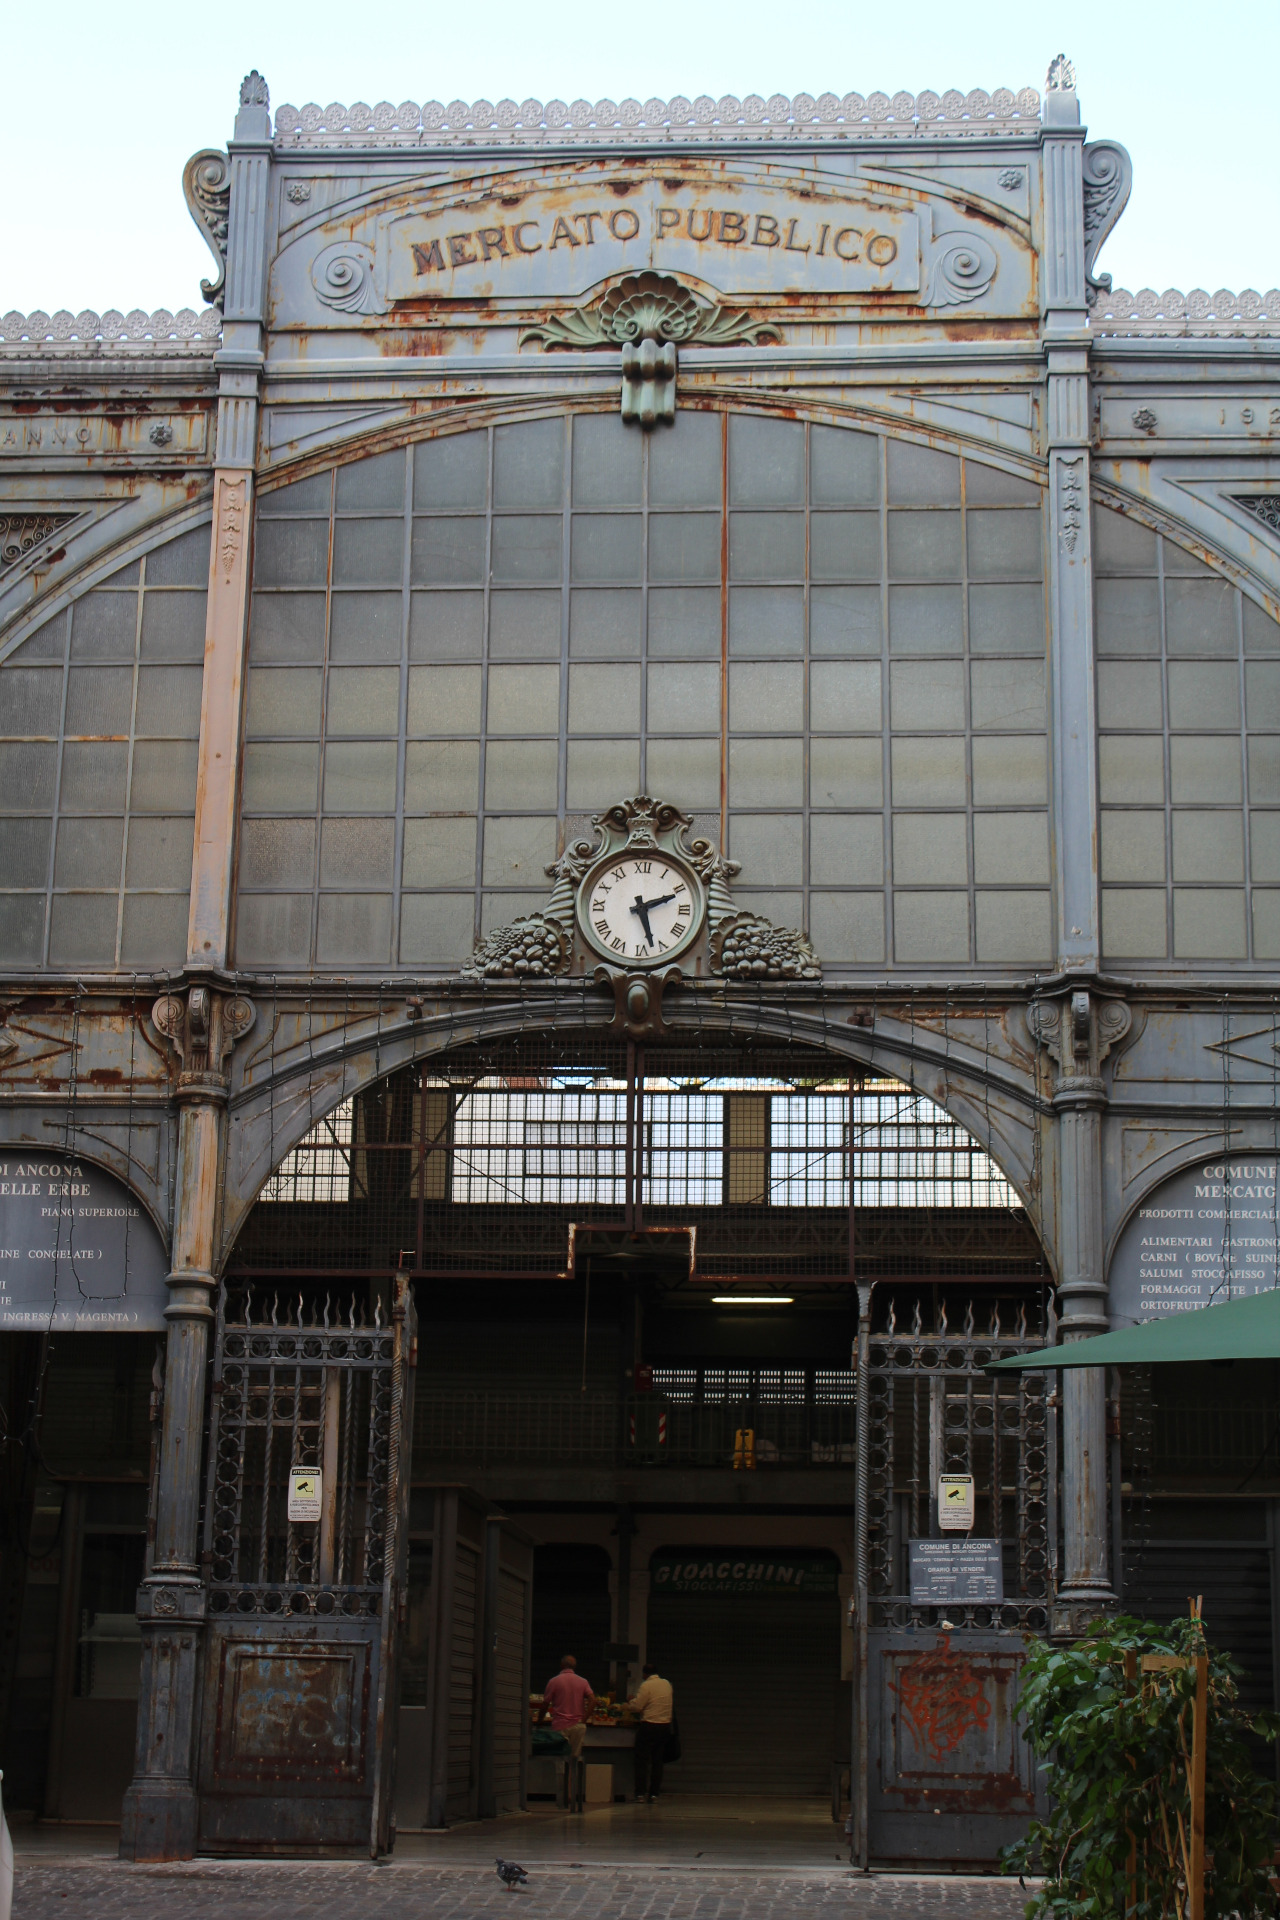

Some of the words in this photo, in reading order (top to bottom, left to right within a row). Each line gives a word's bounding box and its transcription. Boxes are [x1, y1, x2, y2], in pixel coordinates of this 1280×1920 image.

[410, 208, 640, 276] MERCATO
[656, 208, 898, 267] PUBBLICO
[3, 426, 92, 445] ANNO
[611, 866, 627, 882] XI
[633, 861, 653, 874] XII
[598, 881, 612, 894] X
[678, 903, 691, 916] III
[15, 1164, 83, 1177] ANCONA
[1202, 1166, 1277, 1179] COMUNE
[48, 1183, 91, 1196] ERBE
[1194, 1185, 1276, 1198] MERCATO
[41, 1208, 75, 1217] PIANO
[78, 1207, 140, 1217] SUPERIORE
[1139, 1209, 1194, 1219] PRODOTTI
[1140, 1237, 1213, 1247] ALIMENTARI
[28, 1249, 94, 1259] CONGELATE
[1140, 1252, 1177, 1262] CARNI
[1194, 1253, 1237, 1263] BOVINE
[1139, 1268, 1183, 1278] SALUMI
[1191, 1269, 1266, 1279] STOCCAFISSO
[1140, 1284, 1201, 1294] FORMAGGI
[1210, 1285, 1246, 1295] LATTE
[3, 1312, 57, 1322] INGRESSO
[76, 1312, 130, 1322] MAGENTA
[918, 1543, 950, 1551] COMUNE
[655, 1562, 805, 1585] GIOACCHINI
